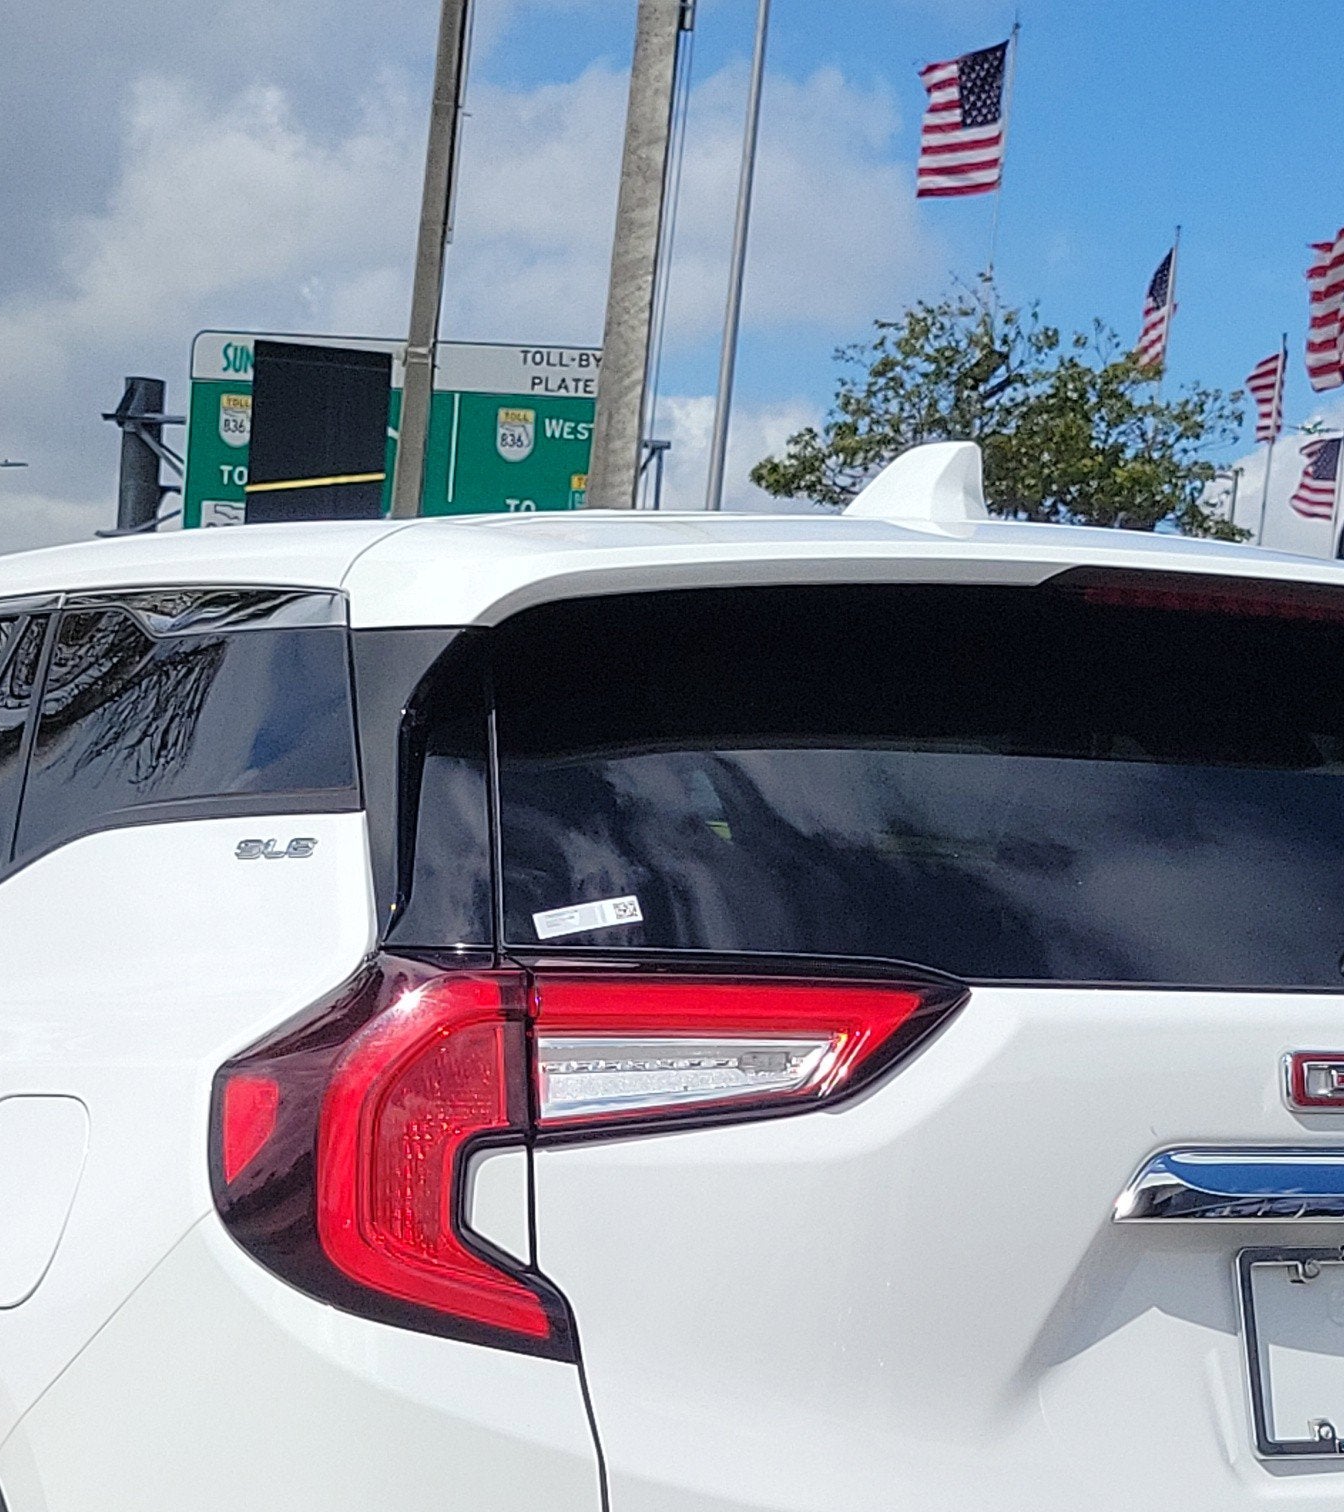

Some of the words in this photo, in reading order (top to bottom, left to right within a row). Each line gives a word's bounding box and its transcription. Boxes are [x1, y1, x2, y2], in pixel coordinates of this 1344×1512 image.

[521, 350, 603, 368] TOLL-BY
[530, 376, 595, 394] PLATE
[226, 396, 251, 408] TOLL
[223, 418, 247, 434] 836
[545, 418, 594, 440] WES
[500, 433, 524, 448] 836
[219, 464, 248, 485] TO
[234, 837, 318, 859] SLE
